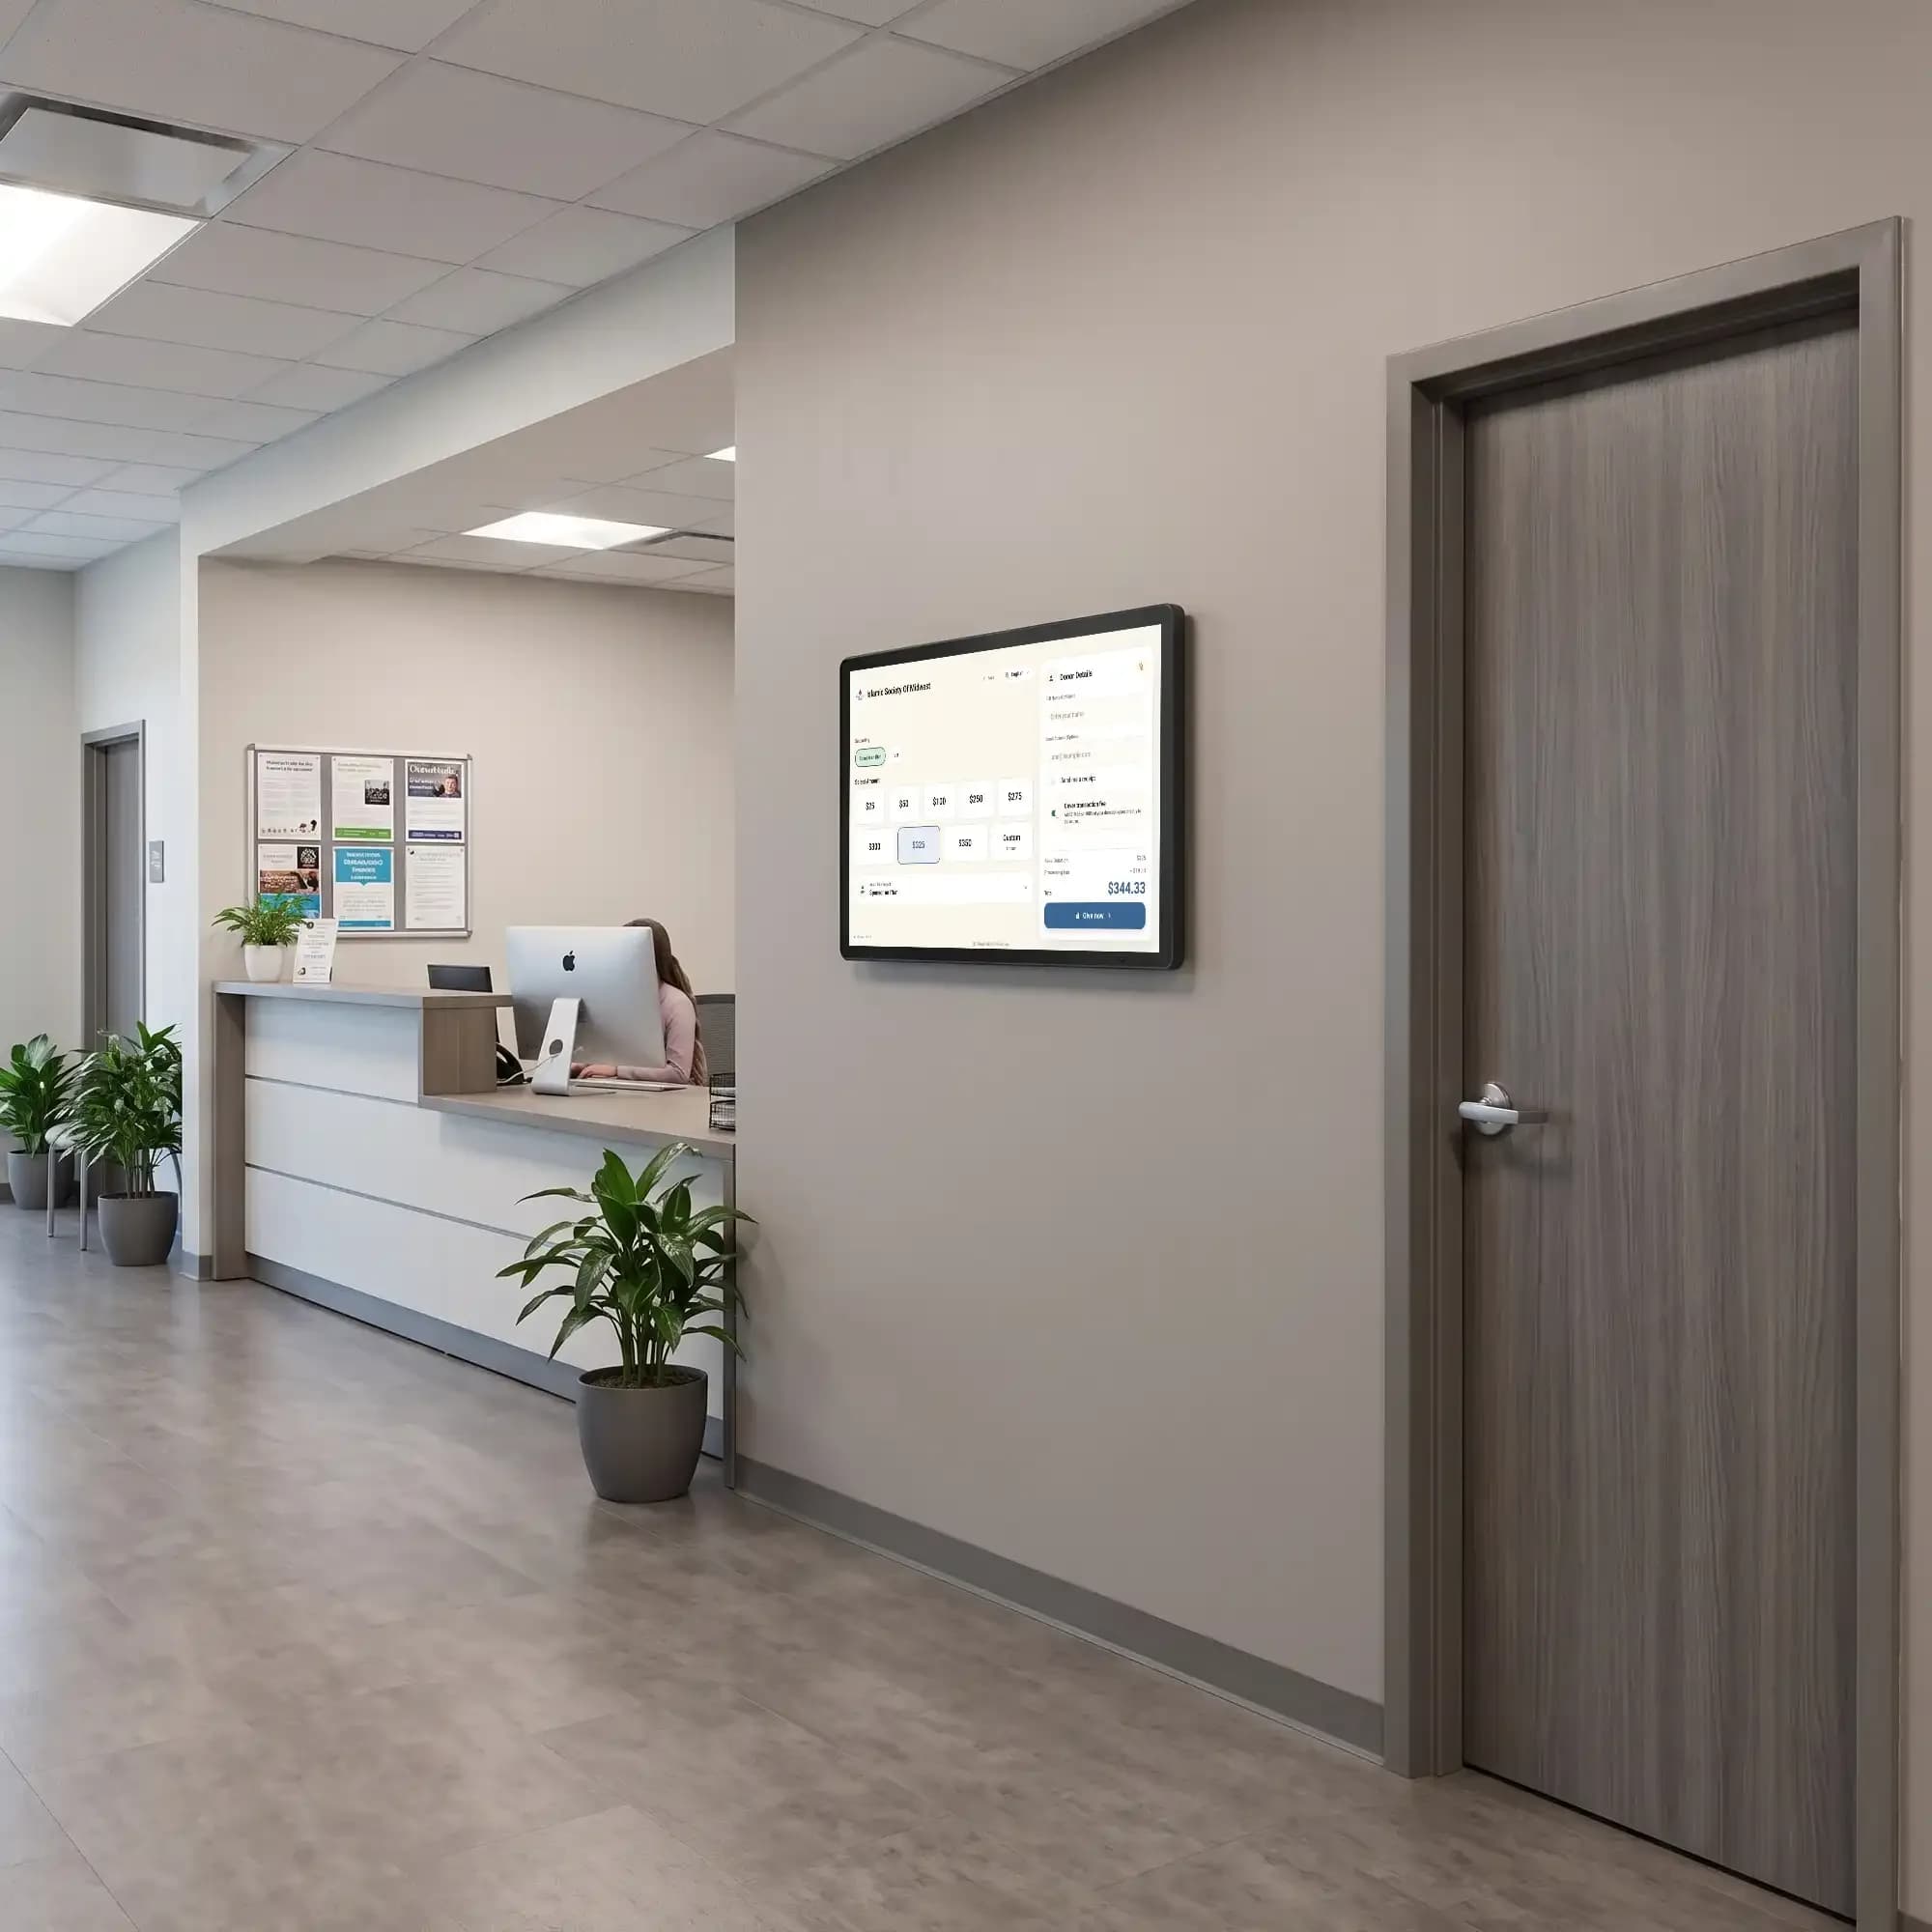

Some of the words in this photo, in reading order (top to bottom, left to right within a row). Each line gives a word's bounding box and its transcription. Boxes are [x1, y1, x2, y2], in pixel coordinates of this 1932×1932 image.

[1075, 669, 1093, 678] Details
[884, 686, 902, 696] Society
[903, 684, 909, 693] Of
[910, 682, 931, 692] Midwest
[969, 794, 983, 804] $250
[1008, 791, 1022, 802] $275
[866, 802, 875, 810] $25
[1107, 881, 1146, 895] $344.33
